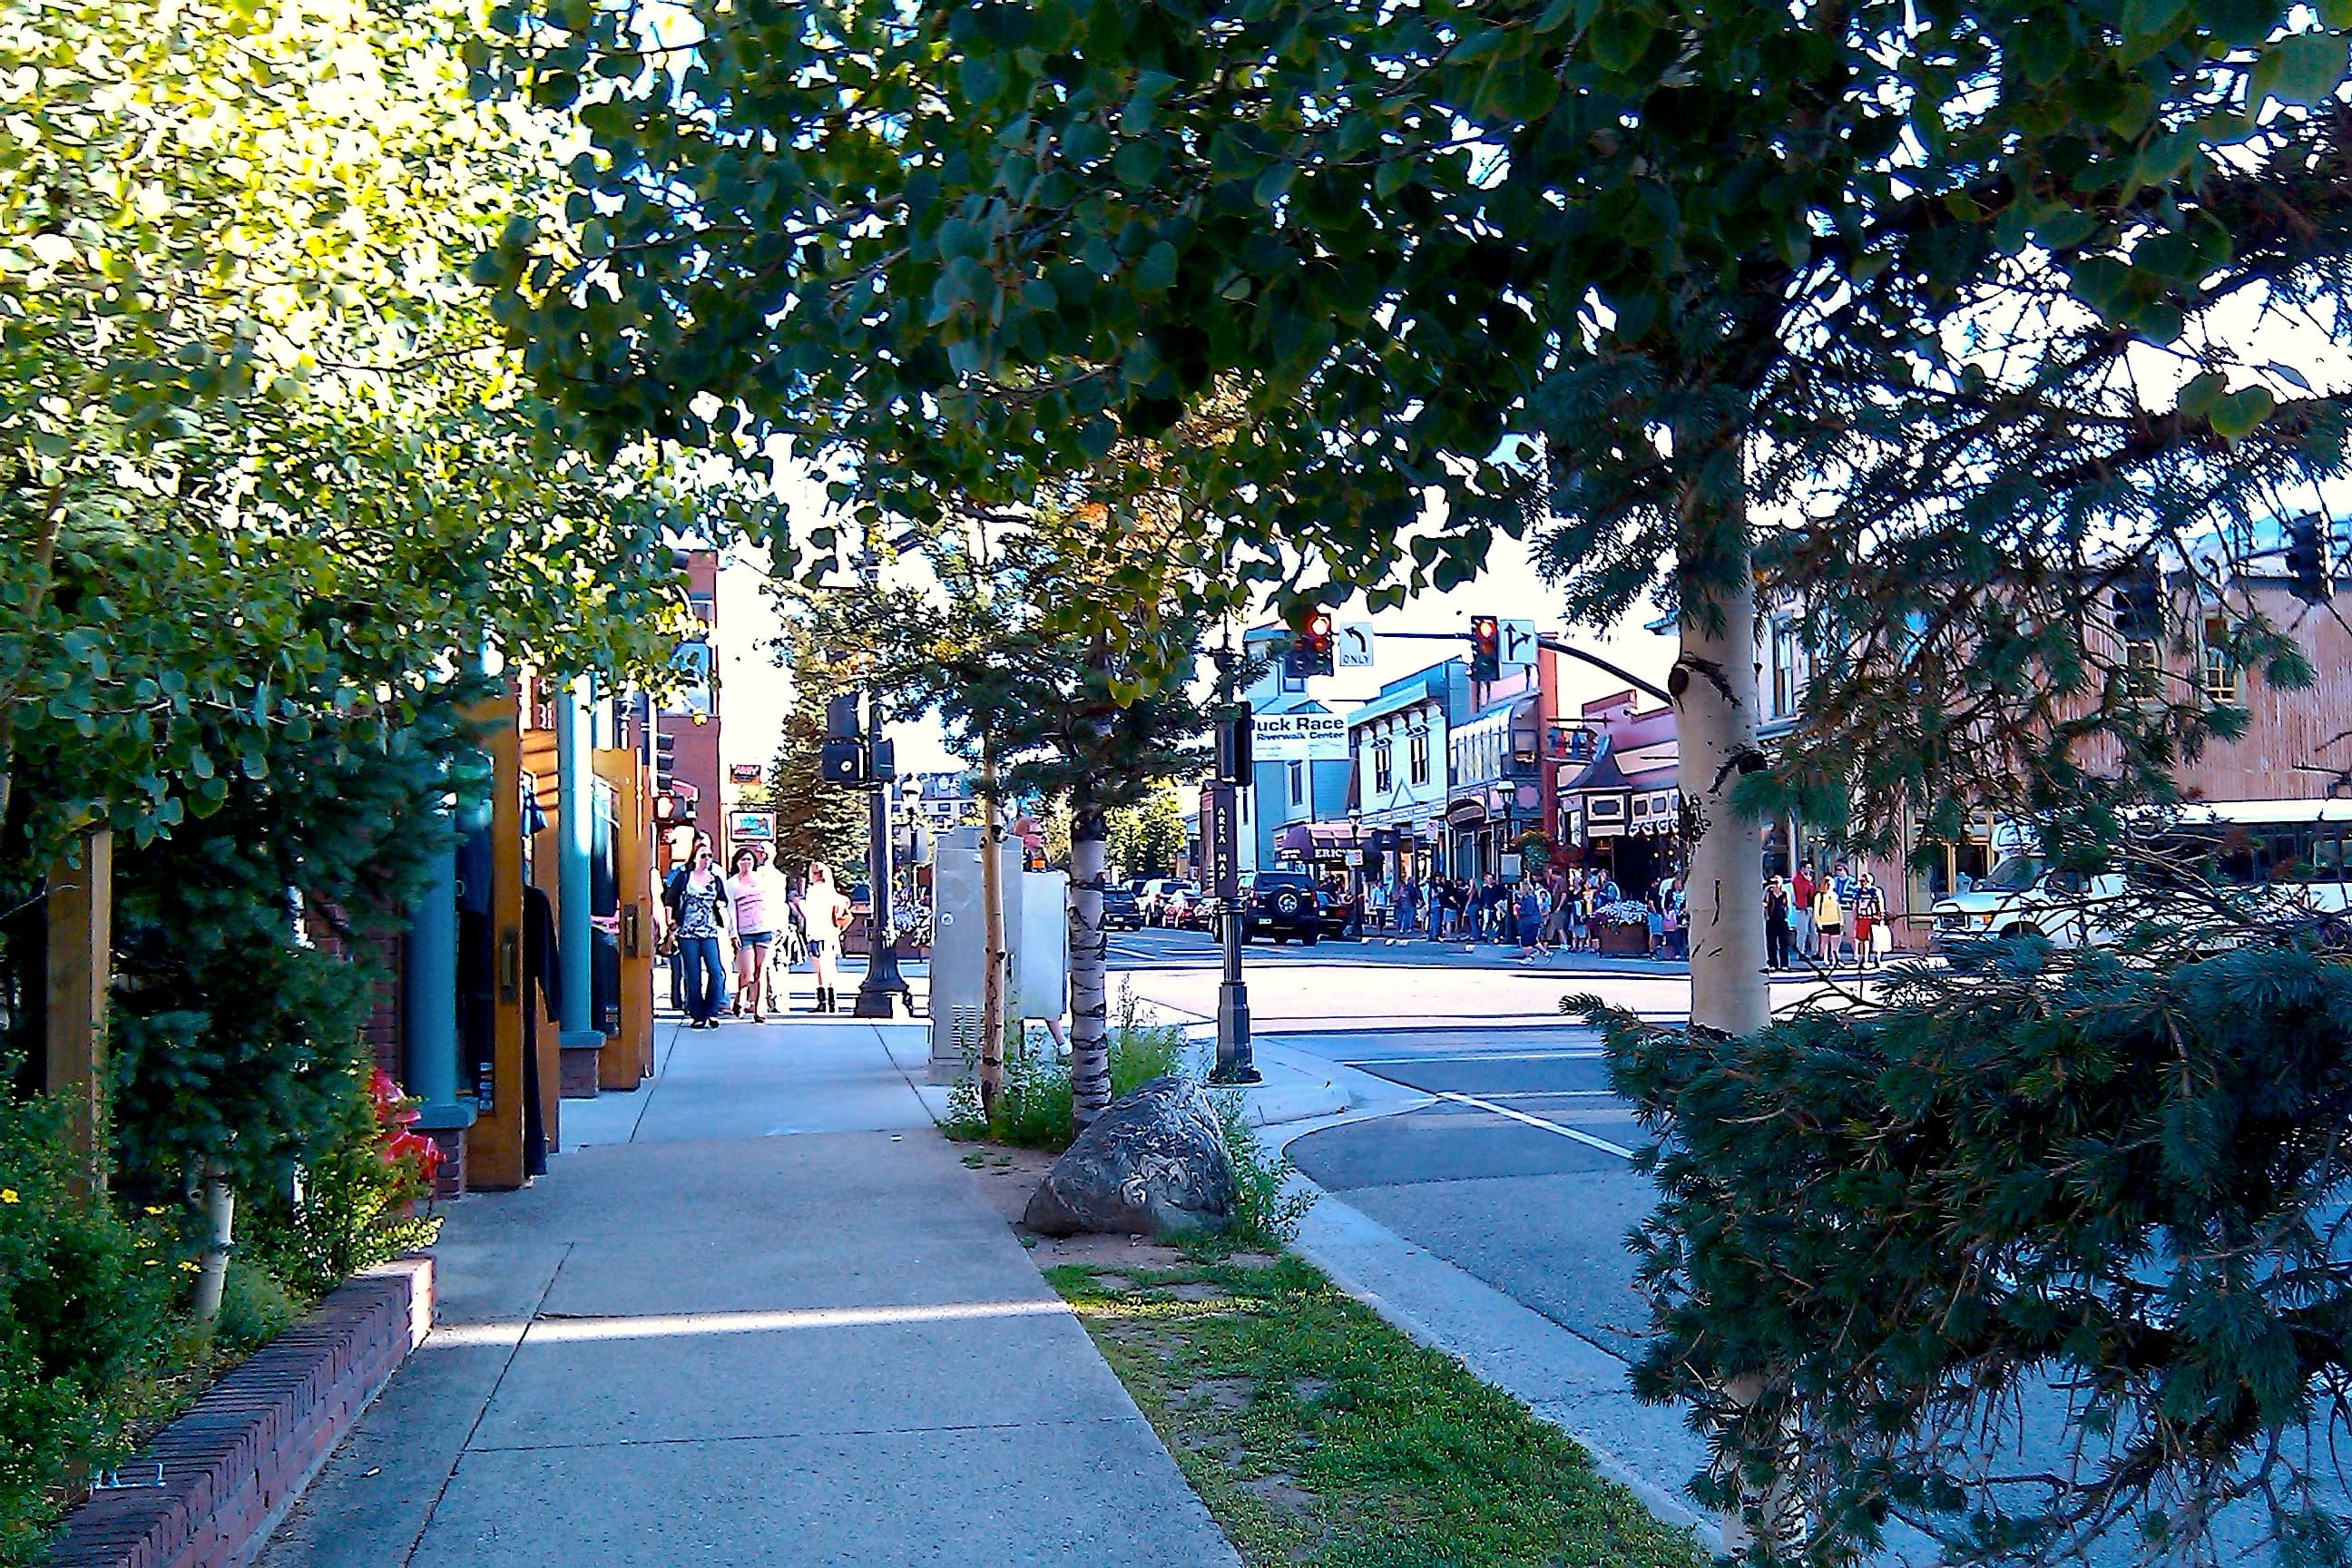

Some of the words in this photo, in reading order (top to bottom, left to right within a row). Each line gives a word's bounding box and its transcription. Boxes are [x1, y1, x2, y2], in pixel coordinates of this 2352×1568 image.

[1343, 654, 1368, 663] ONLY
[1296, 717, 1344, 730] Race
[1257, 731, 1306, 740] Riverwalk
[1309, 731, 1345, 740] Center
[1217, 807, 1227, 844] AREA
[1314, 848, 1349, 858] ERIC'
[1217, 853, 1228, 880] MAP
